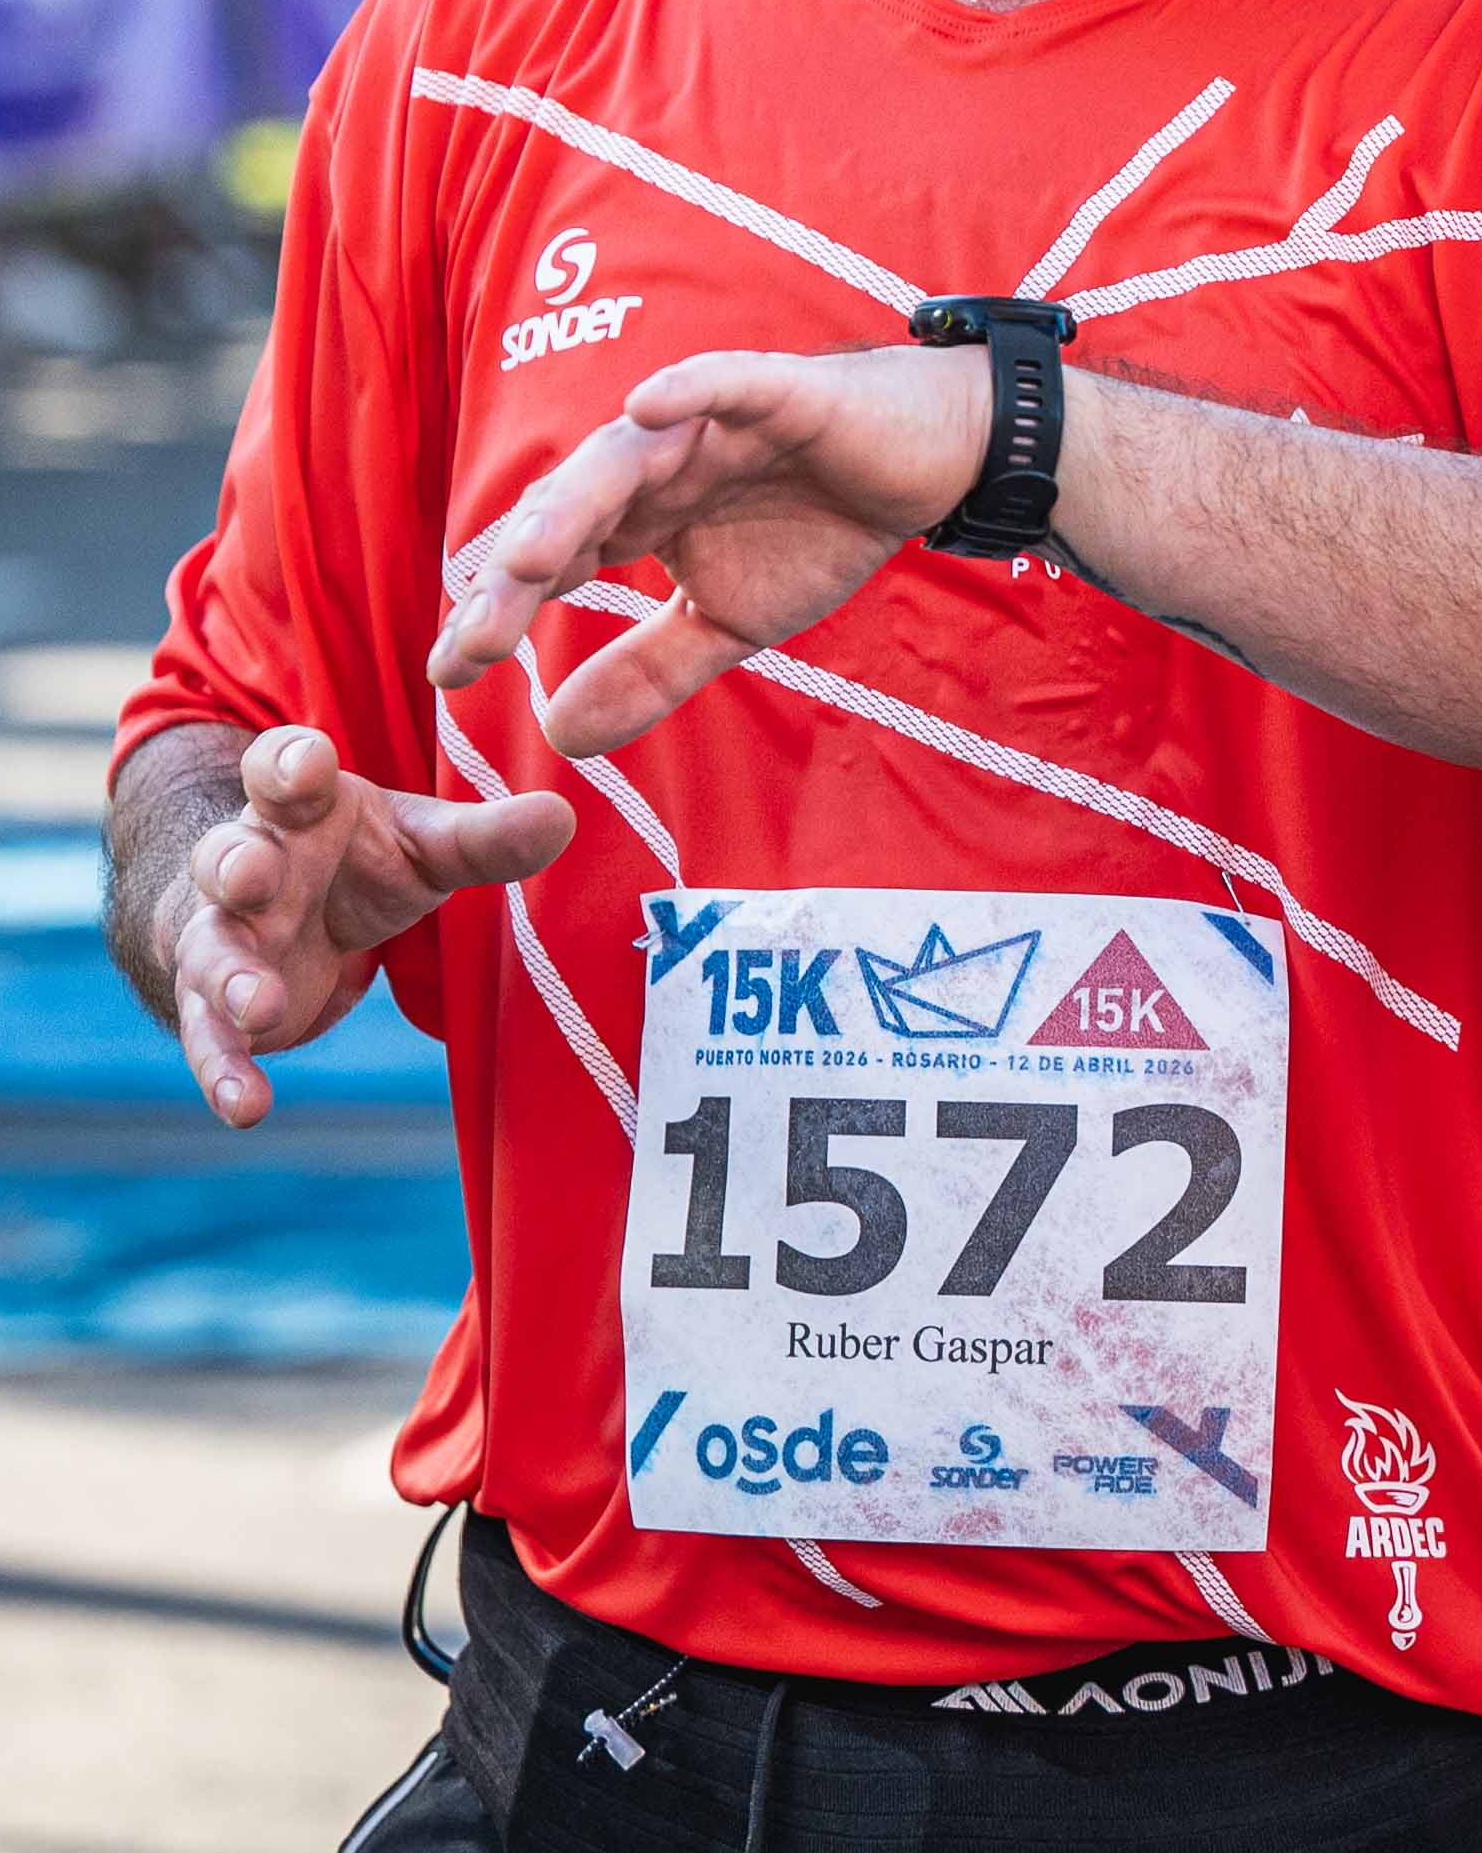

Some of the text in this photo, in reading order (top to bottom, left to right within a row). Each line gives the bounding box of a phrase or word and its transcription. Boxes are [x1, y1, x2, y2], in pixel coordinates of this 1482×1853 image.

[702, 948, 843, 1036] 15K
[1072, 987, 1166, 1034] 15K
[695, 1048, 754, 1067] PUERTO
[759, 1048, 815, 1067] NORTE
[821, 1049, 868, 1067] 2026
[892, 1051, 981, 1069] ROSARIO
[1008, 1055, 1030, 1071] 12
[1038, 1055, 1064, 1072] DE
[1073, 1056, 1135, 1074] ABRIL
[1143, 1058, 1195, 1076] 2026
[650, 1095, 1248, 1305] 1572
[785, 1321, 1054, 1375] Ruber Gaspar
[1345, 1515, 1447, 1559] ARDEC
